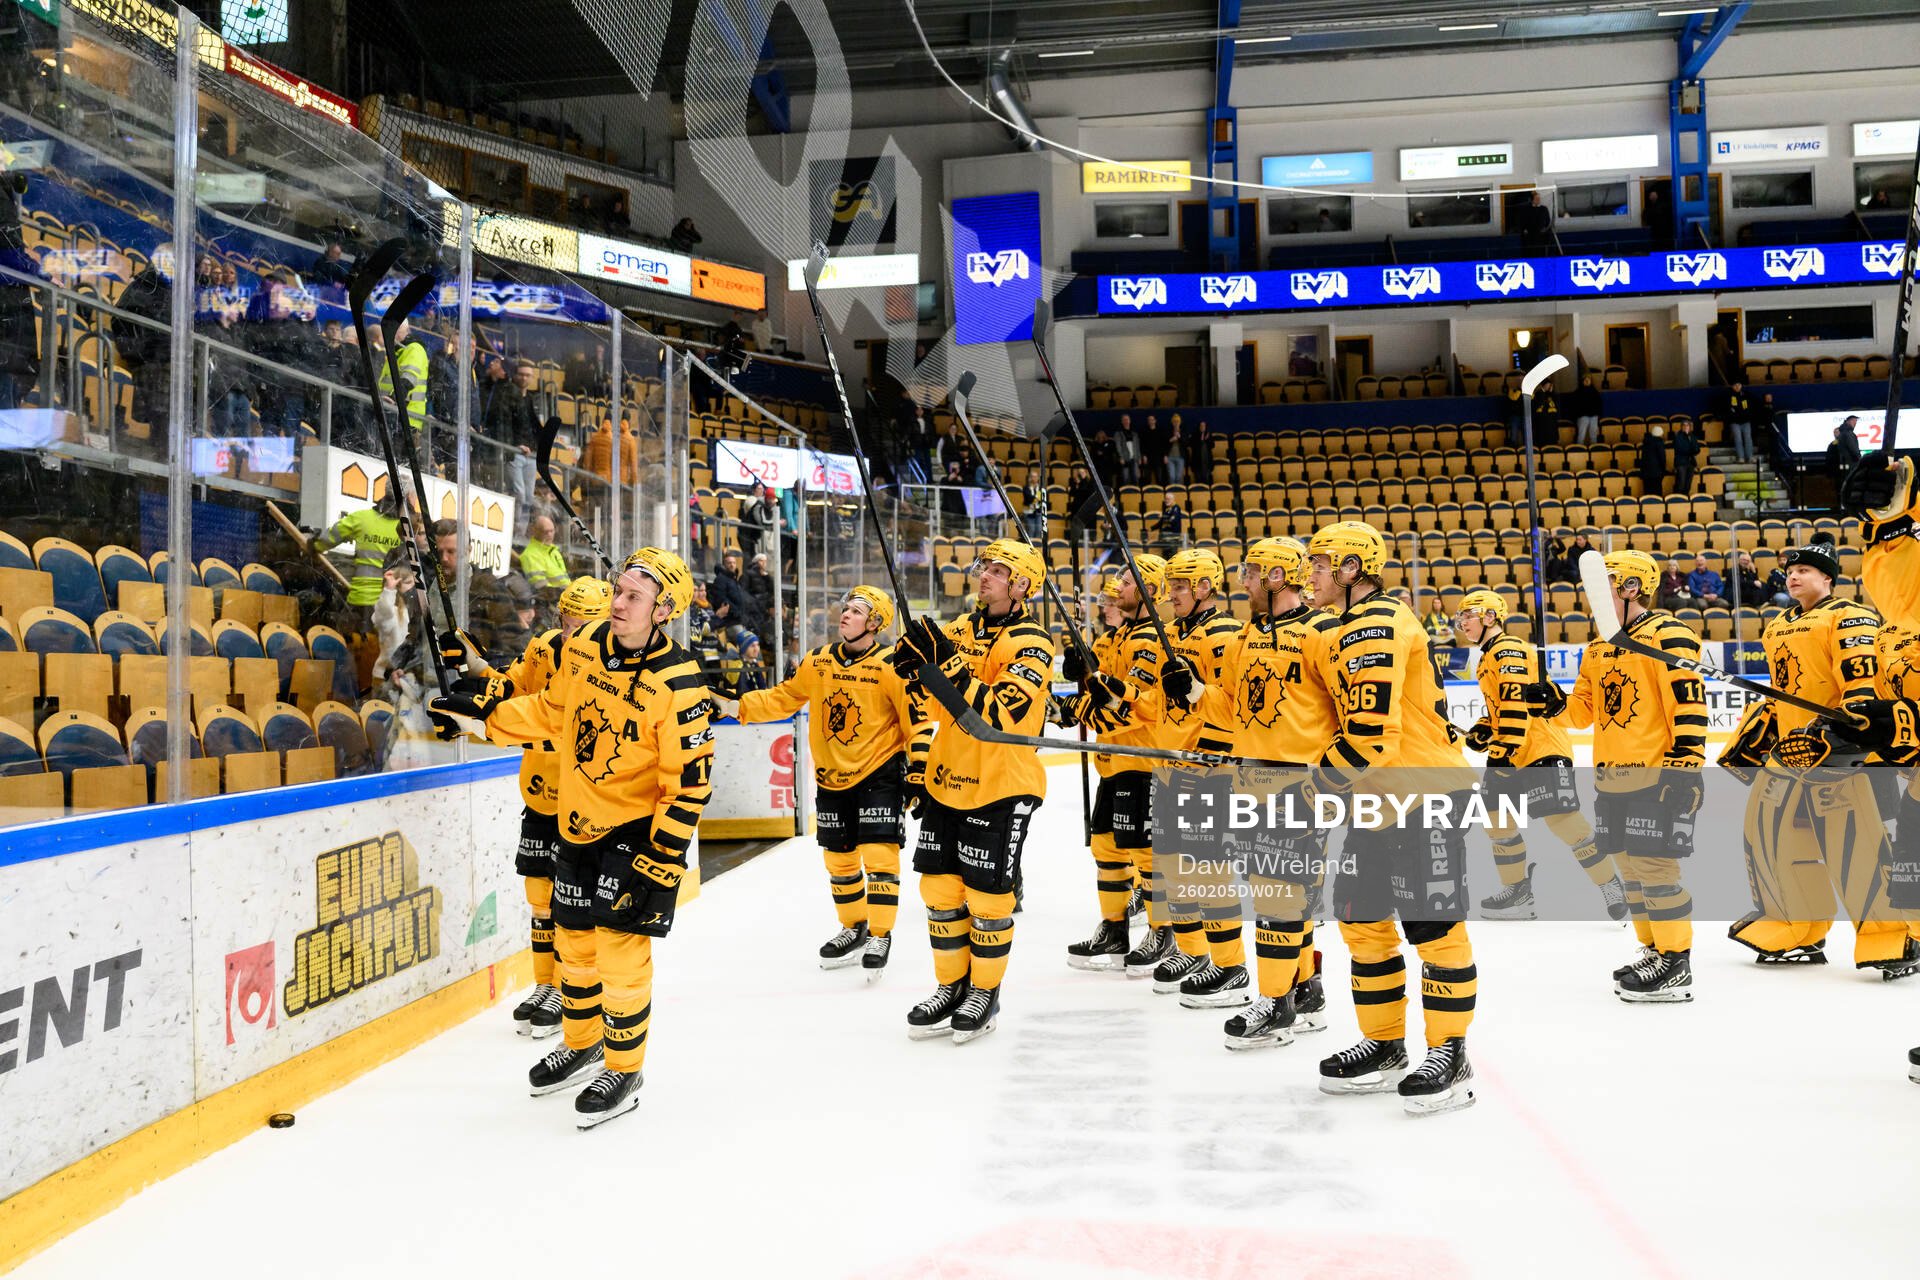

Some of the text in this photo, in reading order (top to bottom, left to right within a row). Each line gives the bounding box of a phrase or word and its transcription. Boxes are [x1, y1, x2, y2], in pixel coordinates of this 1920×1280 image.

[1786, 141, 1821, 152] KPMG
[1459, 154, 1506, 166] MELBYE
[1095, 170, 1180, 184] RAMIRENT
[966, 249, 1029, 287] HV71
[1571, 258, 1630, 290] HV71
[1667, 253, 1726, 285] HV71
[1764, 248, 1824, 281] HV71
[1201, 275, 1257, 307] HV71
[1291, 271, 1348, 304] HV71
[1383, 267, 1441, 300] HV71
[1476, 263, 1535, 295] HV71
[1111, 278, 1167, 309] HV71
[1841, 619, 1878, 627] HOLMEN
[1342, 629, 1386, 646] HOLMEN
[1498, 651, 1523, 659] HOLMEN
[1850, 657, 1875, 677] 31
[1285, 661, 1301, 684] A
[1675, 658, 1735, 684] CCM
[587, 674, 620, 696] BOLIDEN
[997, 685, 1028, 711] 27
[1350, 683, 1378, 711] 96
[1685, 681, 1704, 702] 11
[622, 718, 639, 742] A
[1255, 769, 1290, 777] Skellefteå
[859, 807, 891, 816] BASTU
[859, 816, 896, 824] PRODUKTER
[966, 816, 991, 827] CCM
[1006, 818, 1023, 879] REPAY
[318, 832, 403, 925] EURO
[634, 857, 681, 884] CCM
[284, 887, 434, 1018] JACKPOT
